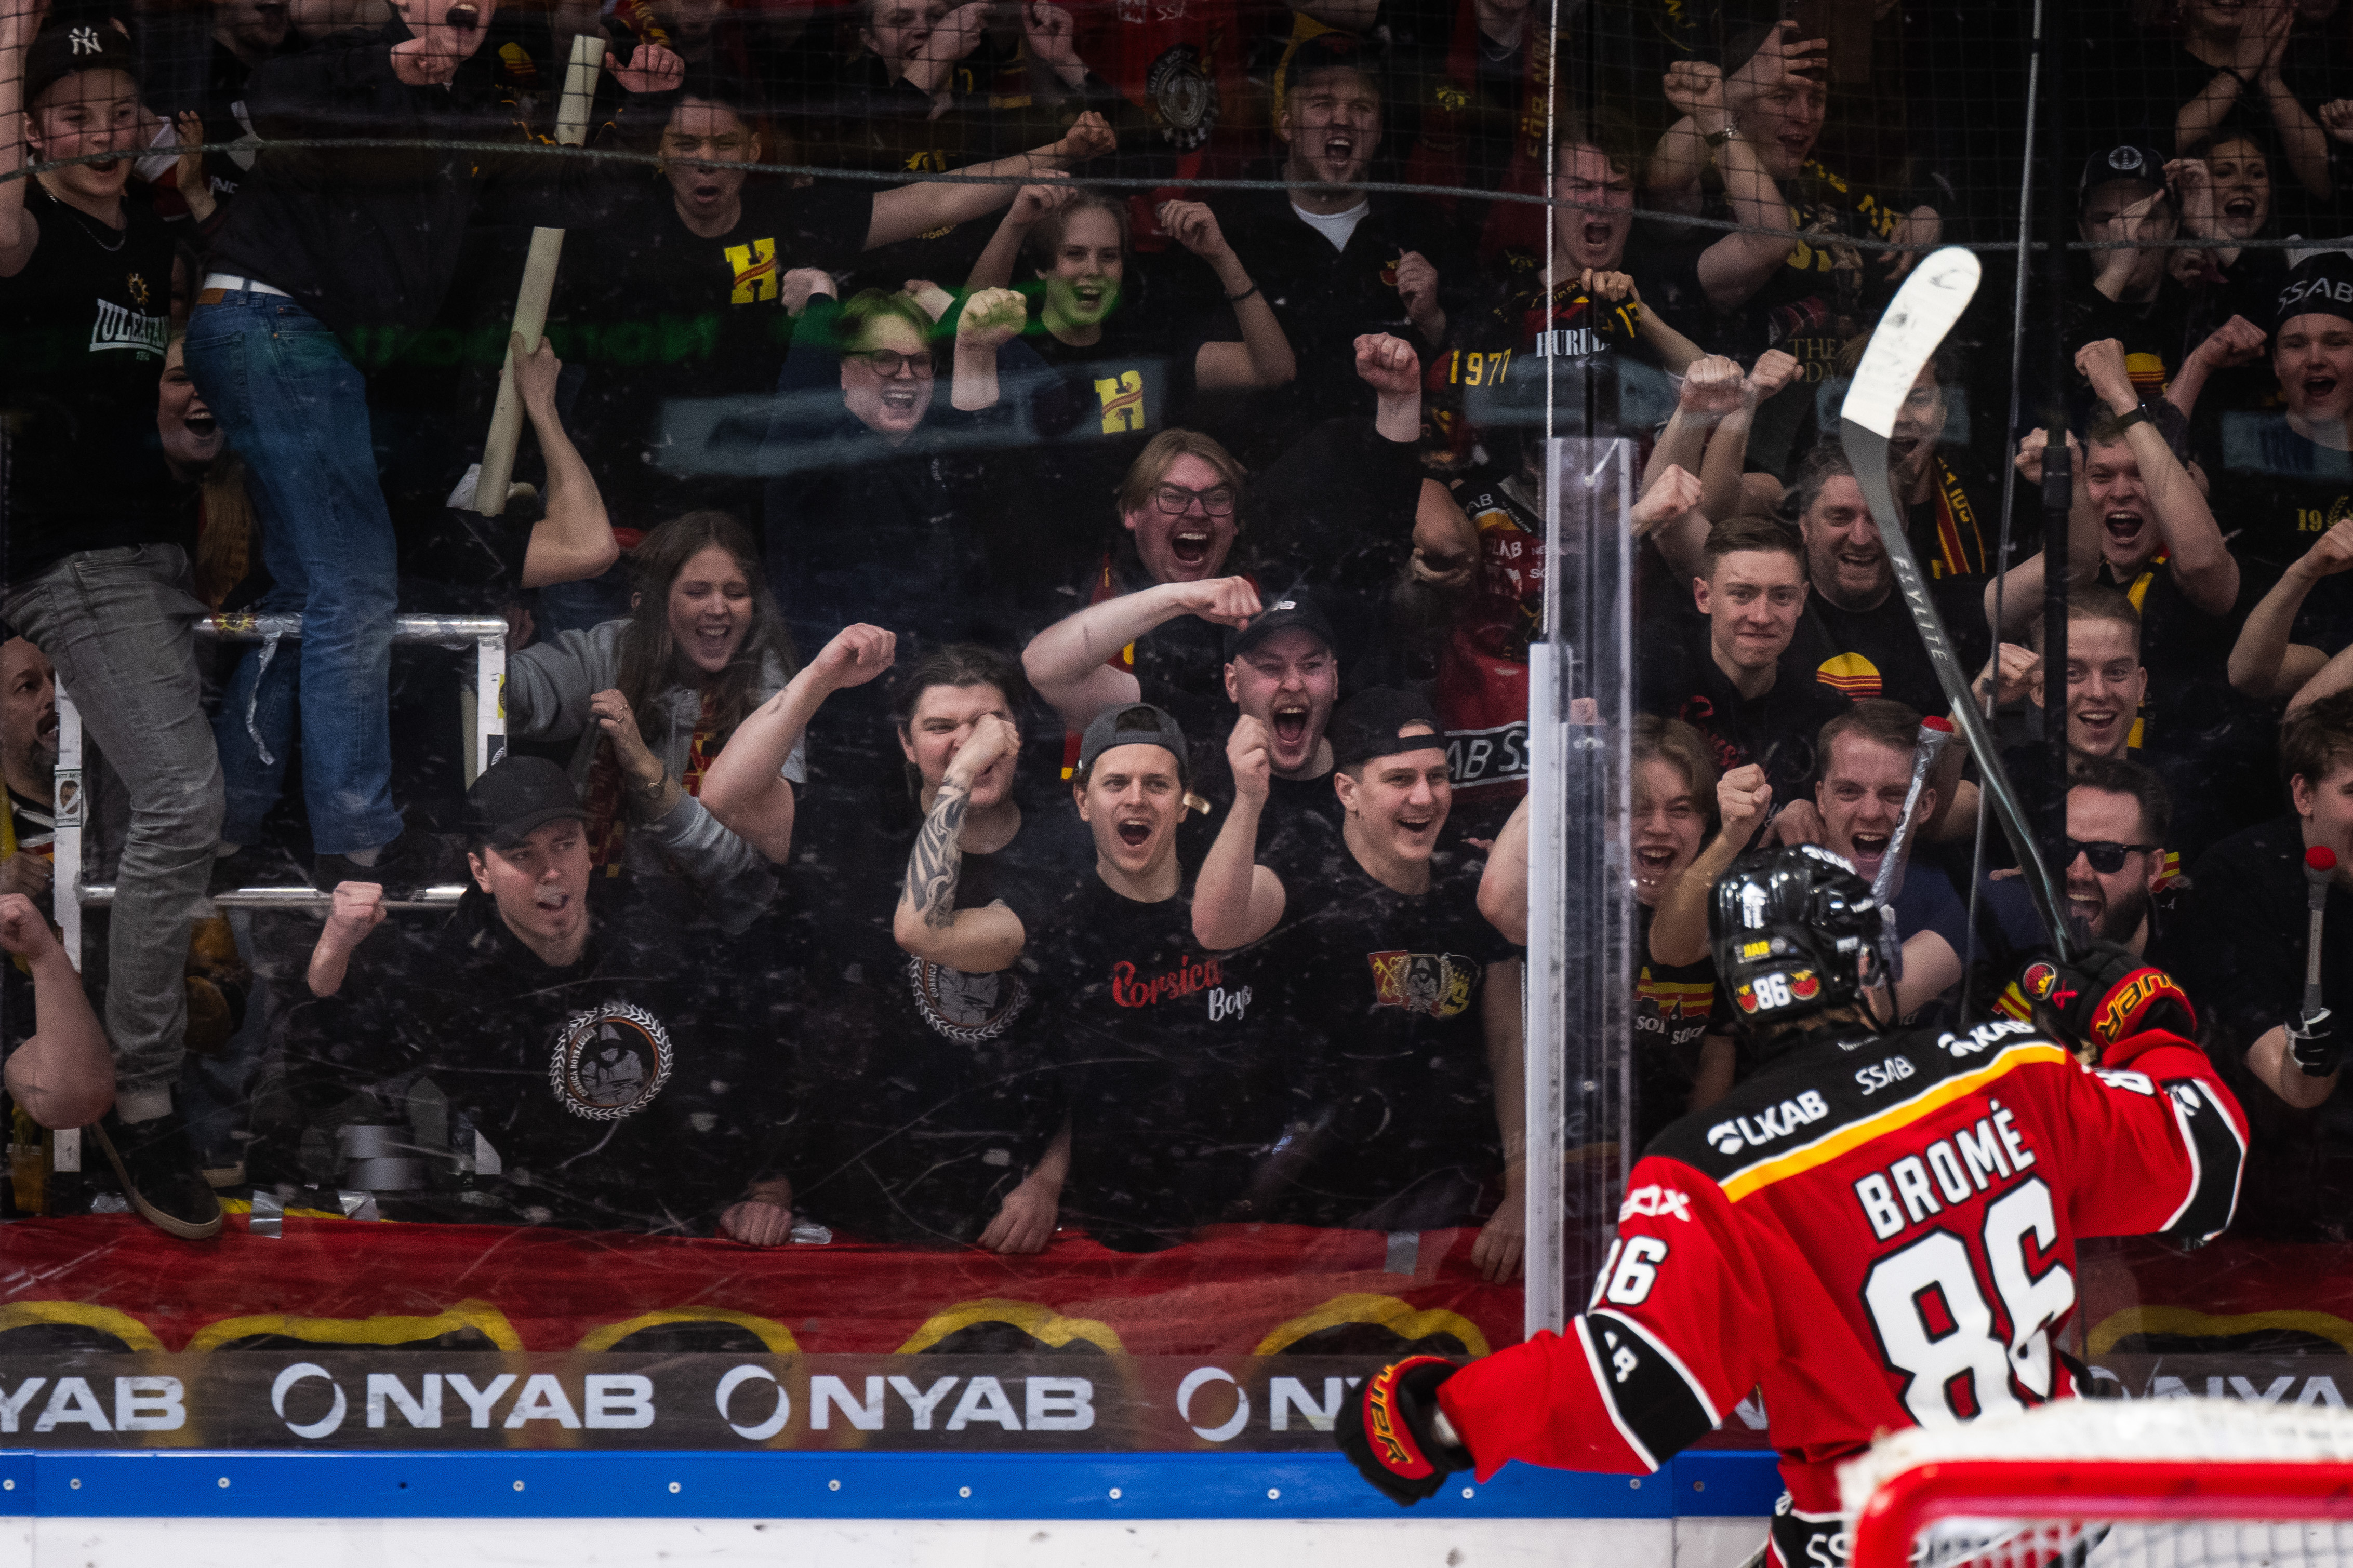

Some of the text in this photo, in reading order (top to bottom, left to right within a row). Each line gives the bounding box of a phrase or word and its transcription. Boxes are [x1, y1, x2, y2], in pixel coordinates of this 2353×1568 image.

[1450, 347, 1512, 386] 1977
[1112, 955, 1224, 1008] Corsica
[1208, 985, 1253, 1022] Boys
[1752, 972, 1791, 1010] 86
[1855, 1055, 1916, 1095] SSAB
[1737, 1089, 1829, 1146] LKAB
[1854, 1098, 2037, 1241] BROMÉ
[366, 1374, 656, 1429] NYAB
[809, 1376, 1095, 1431] NYAB
